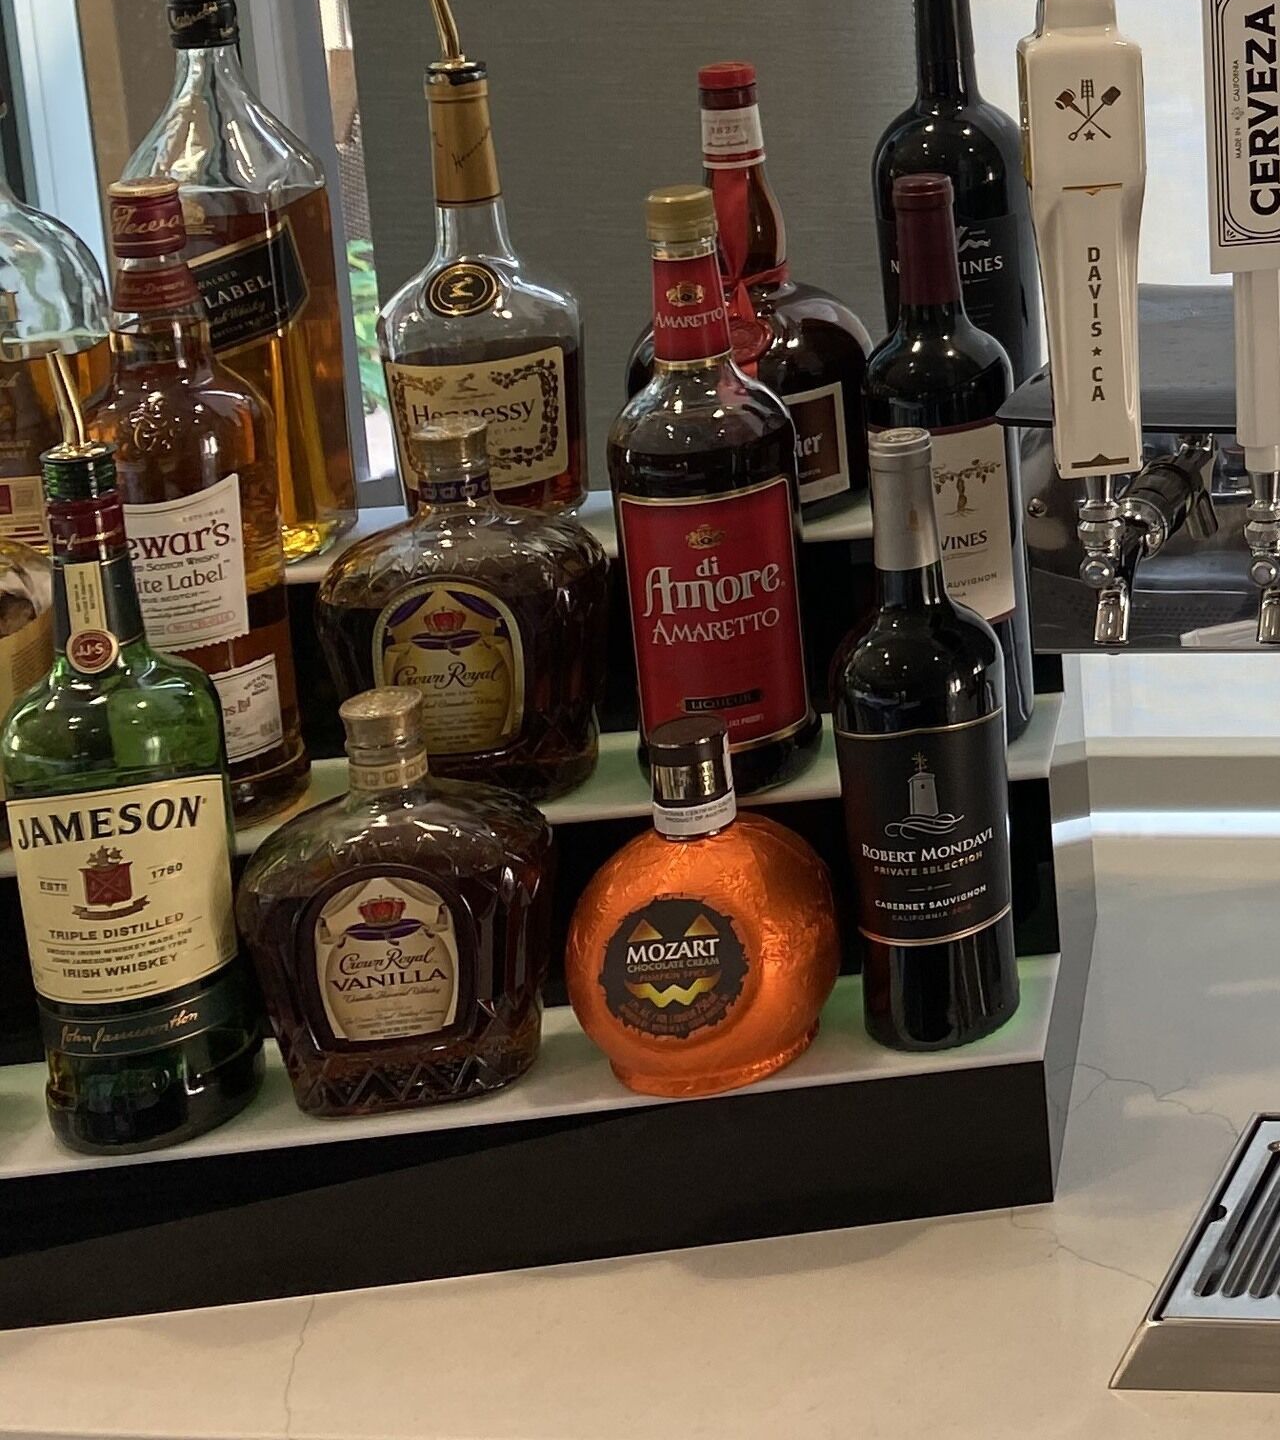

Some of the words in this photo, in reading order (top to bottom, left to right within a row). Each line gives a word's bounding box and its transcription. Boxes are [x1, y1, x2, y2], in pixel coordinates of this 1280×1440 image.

[1232, 60, 1240, 101] CALIFORNIA
[1234, 127, 1241, 136] IN
[961, 256, 1004, 274] INES
[203, 274, 272, 309] LABEL
[1087, 246, 1103, 338] DAVIS
[655, 308, 724, 329] AMARETTO
[1091, 366, 1106, 402] CA
[412, 398, 536, 426] Heessy
[127, 519, 231, 560] ewar's
[136, 578, 162, 594] ite
[168, 564, 223, 592] Label
[696, 556, 719, 577] di
[946, 572, 998, 589] AUVIGNON
[642, 563, 781, 618] Amore
[652, 607, 780, 645] AMARETTO
[395, 665, 444, 687] Crown
[436, 661, 500, 689] Royal
[18, 795, 202, 850] JAMESON
[862, 843, 916, 863] ROBERT
[921, 827, 994, 861] MONDAVI
[874, 865, 917, 876] PRIVATE
[922, 850, 983, 875] SELECTION
[875, 898, 925, 911] CABERNET
[929, 884, 987, 908] SAUVIGNON
[48, 929, 97, 941] TRIPLE
[103, 913, 184, 938] DISTILLED
[892, 910, 948, 922] CALIFORNIA
[104, 942, 146, 956] WHISKEY
[148, 933, 174, 946] MADE
[177, 927, 193, 937] THE
[626, 938, 720, 964] MOZART
[63, 967, 101, 979] IRISH
[105, 952, 178, 978] WHISKEY
[340, 953, 385, 975] Crown
[381, 946, 435, 970] Royal
[627, 962, 684, 973] CHOCOLATE
[686, 958, 719, 968] CREAM
[330, 967, 448, 992] VANILLA
